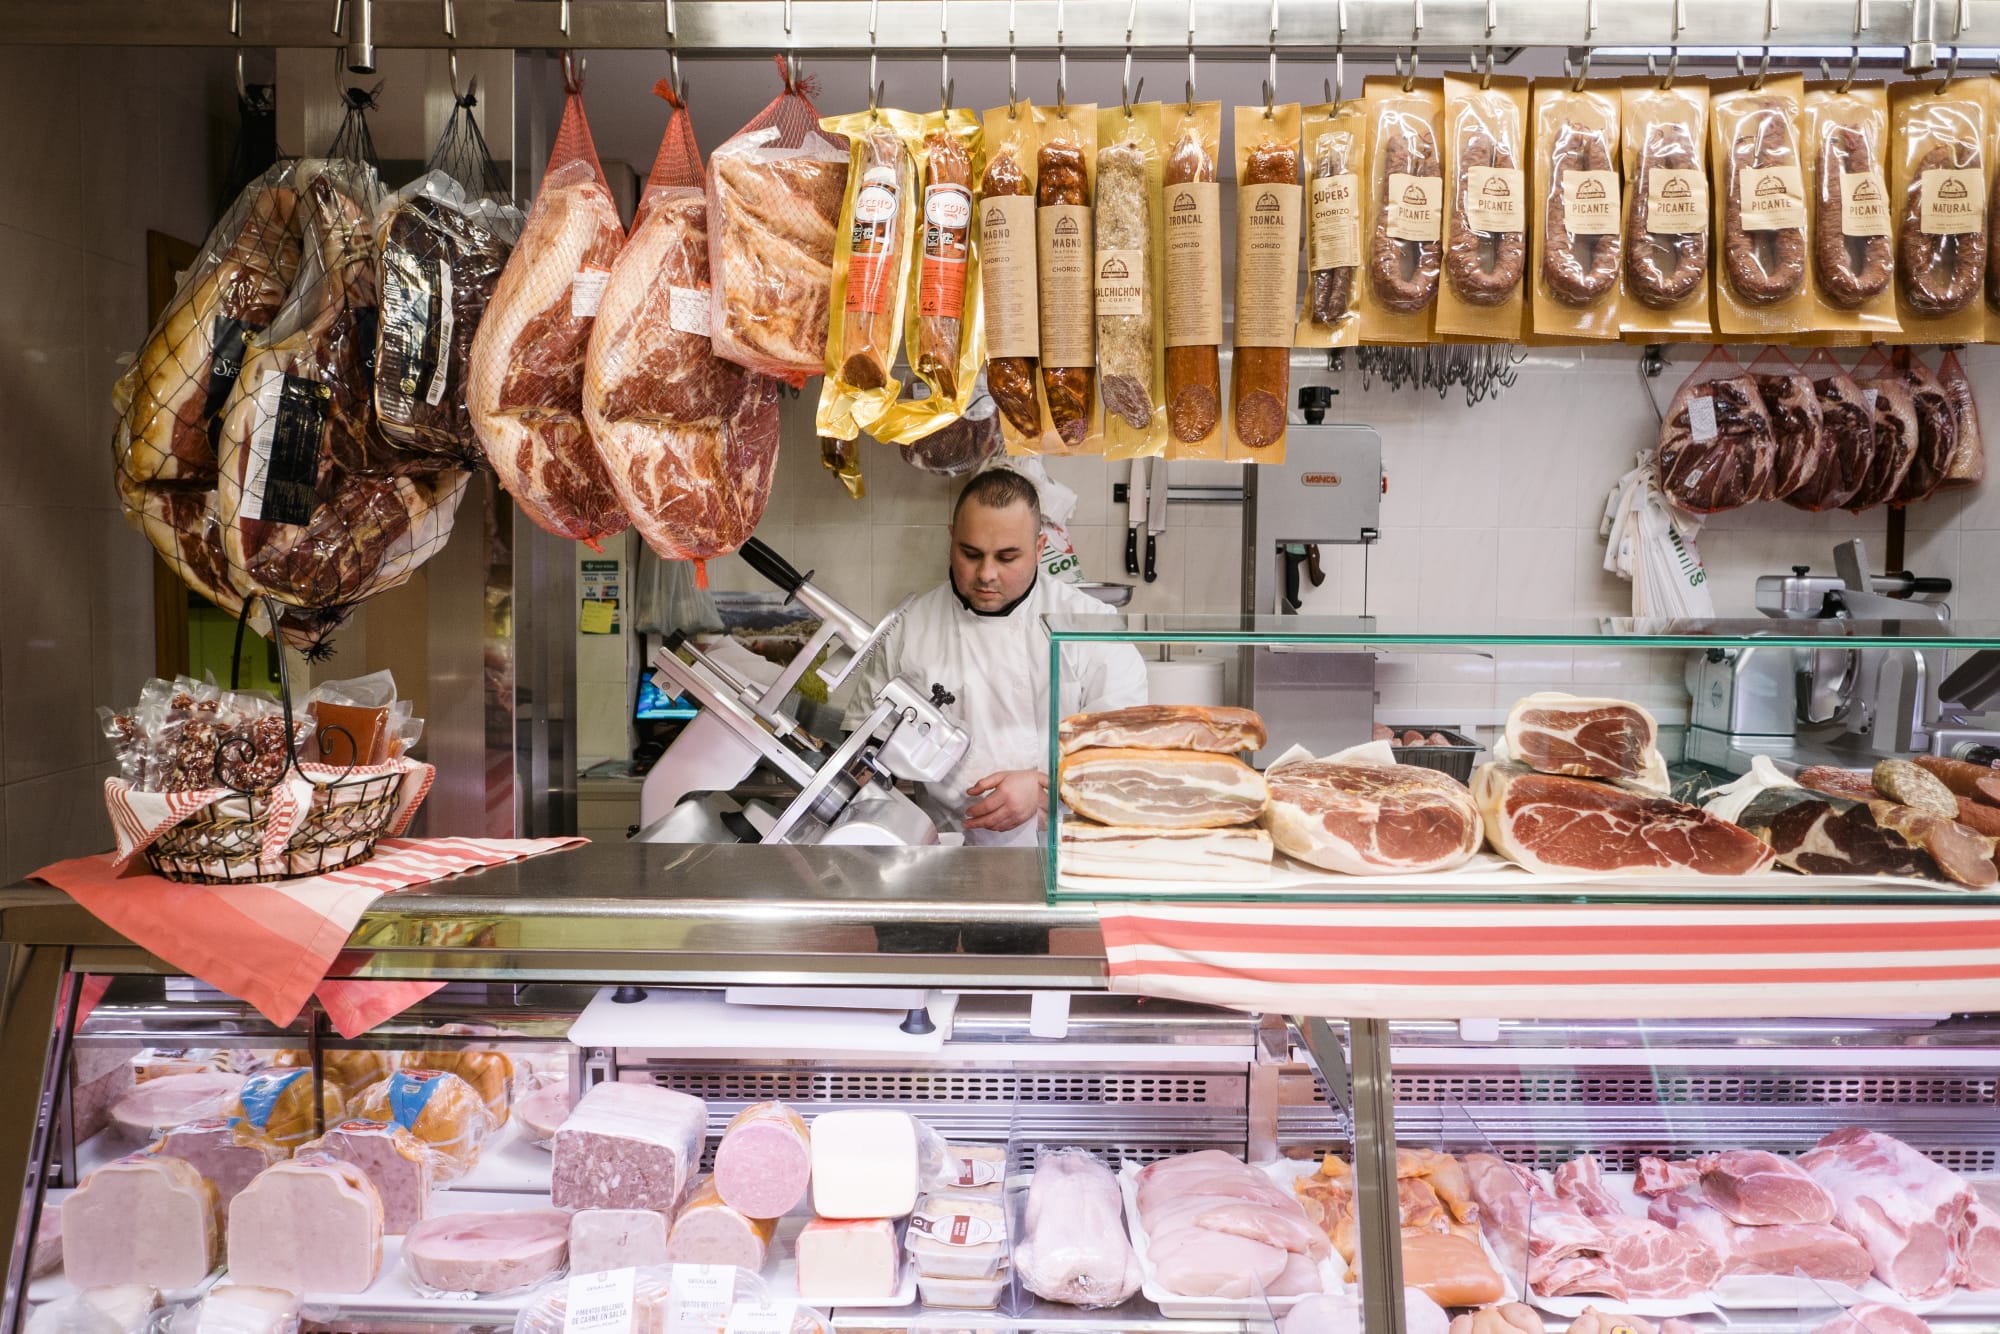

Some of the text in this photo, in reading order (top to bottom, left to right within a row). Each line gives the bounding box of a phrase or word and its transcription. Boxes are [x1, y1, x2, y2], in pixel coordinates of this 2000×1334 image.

[1313, 187, 1349, 205] SUPERS
[1479, 199, 1513, 212] PICANTE
[1572, 203, 1609, 214] PICANTE
[1657, 202, 1696, 213] PICANTE
[1752, 199, 1792, 211] PICANTE
[1932, 202, 1973, 213] NATURAL
[1315, 208, 1350, 219] CHORIZO
[1398, 207, 1431, 220] PICANTE
[1168, 214, 1203, 226] TRONCAL
[1249, 215, 1285, 226] TRONCAL
[983, 229, 1010, 241] MAGNO
[1052, 238, 1082, 249] MAGNO
[1171, 241, 1200, 250] CHORIZO
[984, 256, 1010, 265] CHORIZO
[580, 1314, 599, 1325] CARNE
[609, 1309, 627, 1319] SALSA
